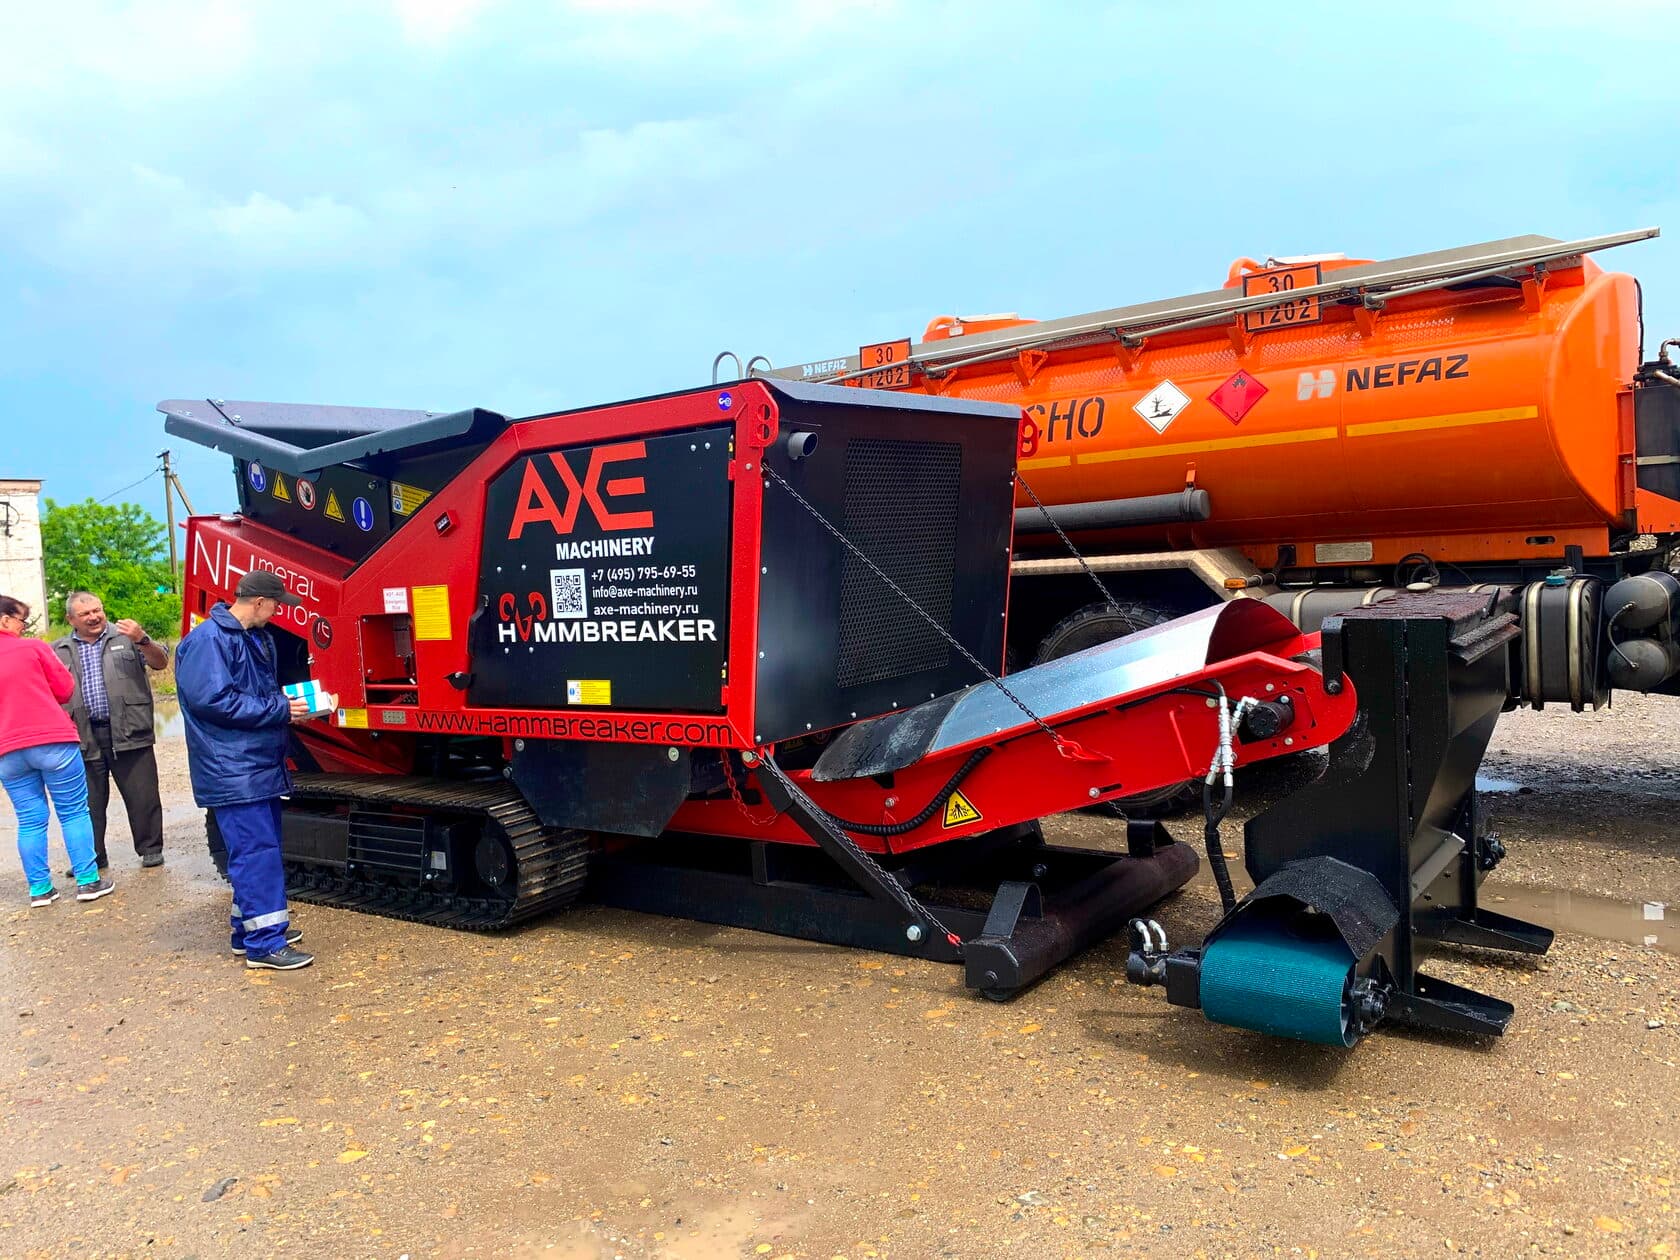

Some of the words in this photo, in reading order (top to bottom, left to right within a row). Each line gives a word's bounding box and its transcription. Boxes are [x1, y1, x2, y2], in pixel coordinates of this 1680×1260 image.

[1269, 274, 1294, 293] 30
[1257, 298, 1311, 325] 1202
[876, 346, 893, 364] 30
[868, 367, 904, 388] 1202
[1346, 354, 1469, 392] NEFAZ
[508, 440, 654, 539] AXE
[556, 537, 655, 560] MACHINERY
[193, 530, 255, 590] NH
[591, 569, 604, 581] +7
[607, 567, 635, 582] (495)
[638, 565, 696, 580] 795-69-55
[592, 585, 698, 599] info@axe-machinery.ru
[593, 602, 699, 617] axe-machinery.ru
